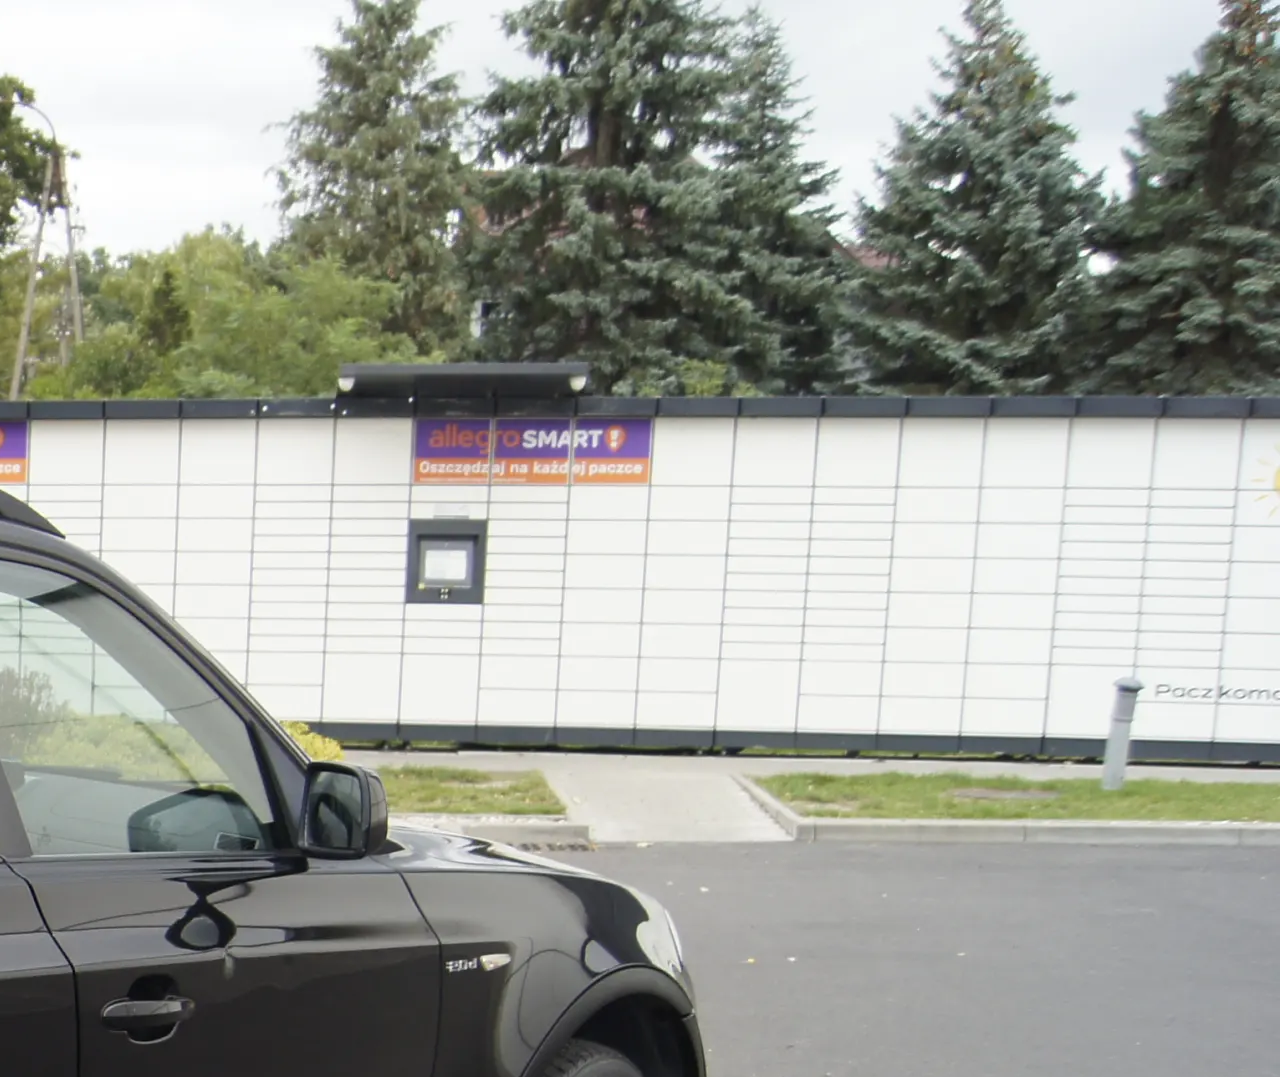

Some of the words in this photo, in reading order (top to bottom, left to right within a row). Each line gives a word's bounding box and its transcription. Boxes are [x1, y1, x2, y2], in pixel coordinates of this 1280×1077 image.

[429, 424, 520, 454] allegro
[419, 461, 505, 476] Oszczędzaj
[509, 463, 528, 473] na
[533, 460, 587, 476] każdej
[588, 463, 644, 476] paczce
